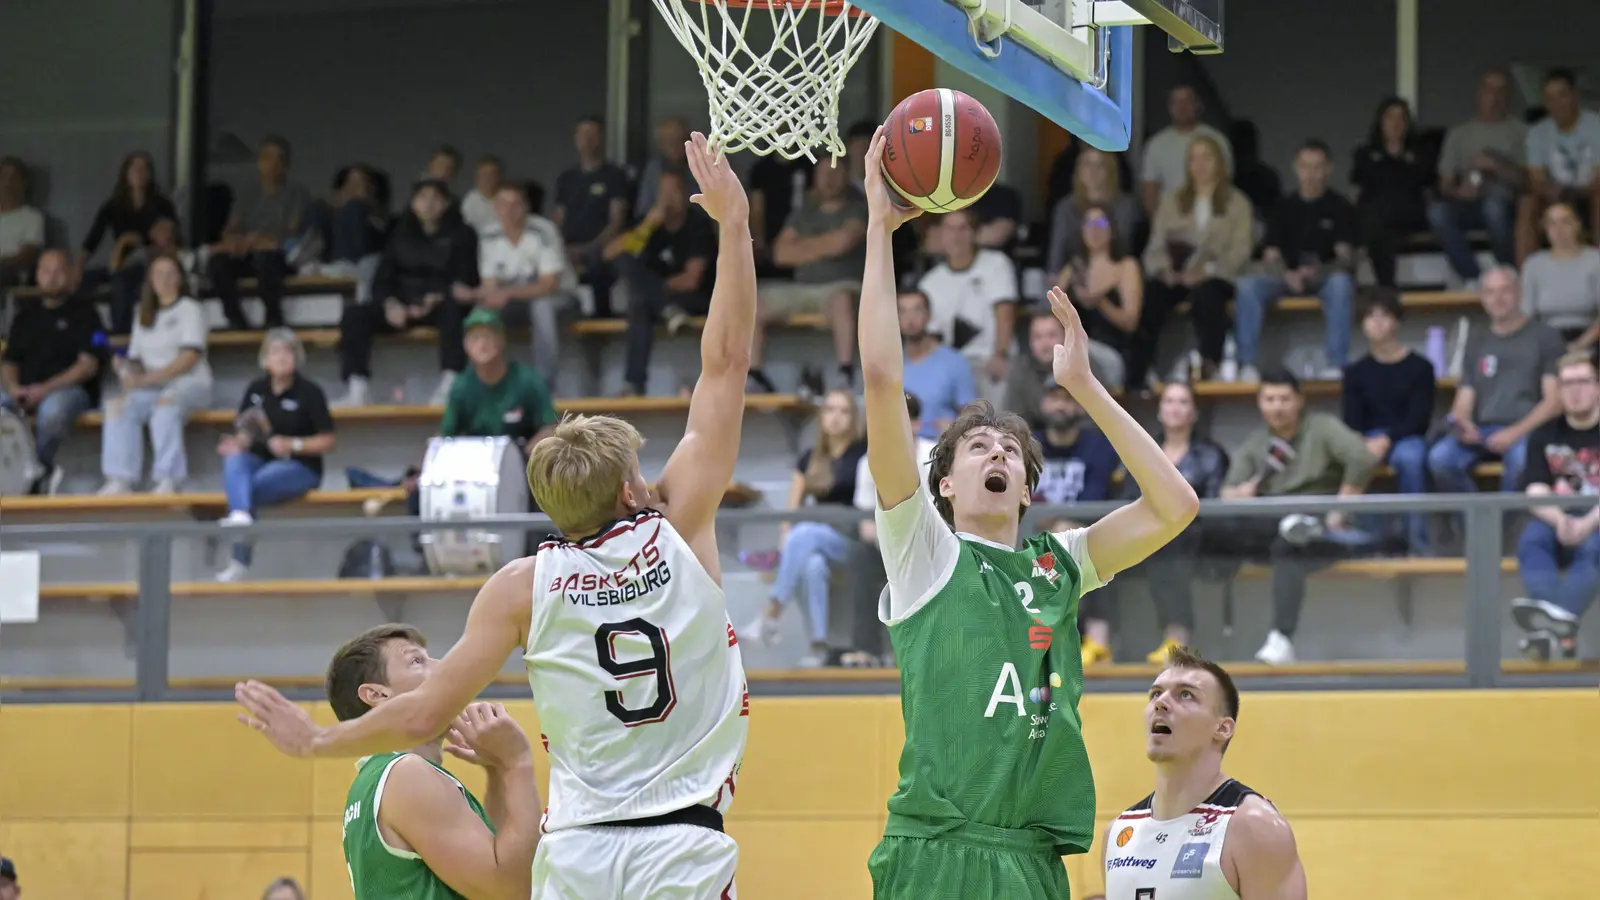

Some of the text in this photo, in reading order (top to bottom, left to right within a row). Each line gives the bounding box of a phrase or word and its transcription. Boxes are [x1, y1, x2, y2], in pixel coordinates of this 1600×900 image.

[549, 521, 661, 604] BASKETS
[569, 560, 671, 606] VILSBIBURG
[594, 617, 678, 728] 9
[1111, 856, 1158, 871] Flottweg
